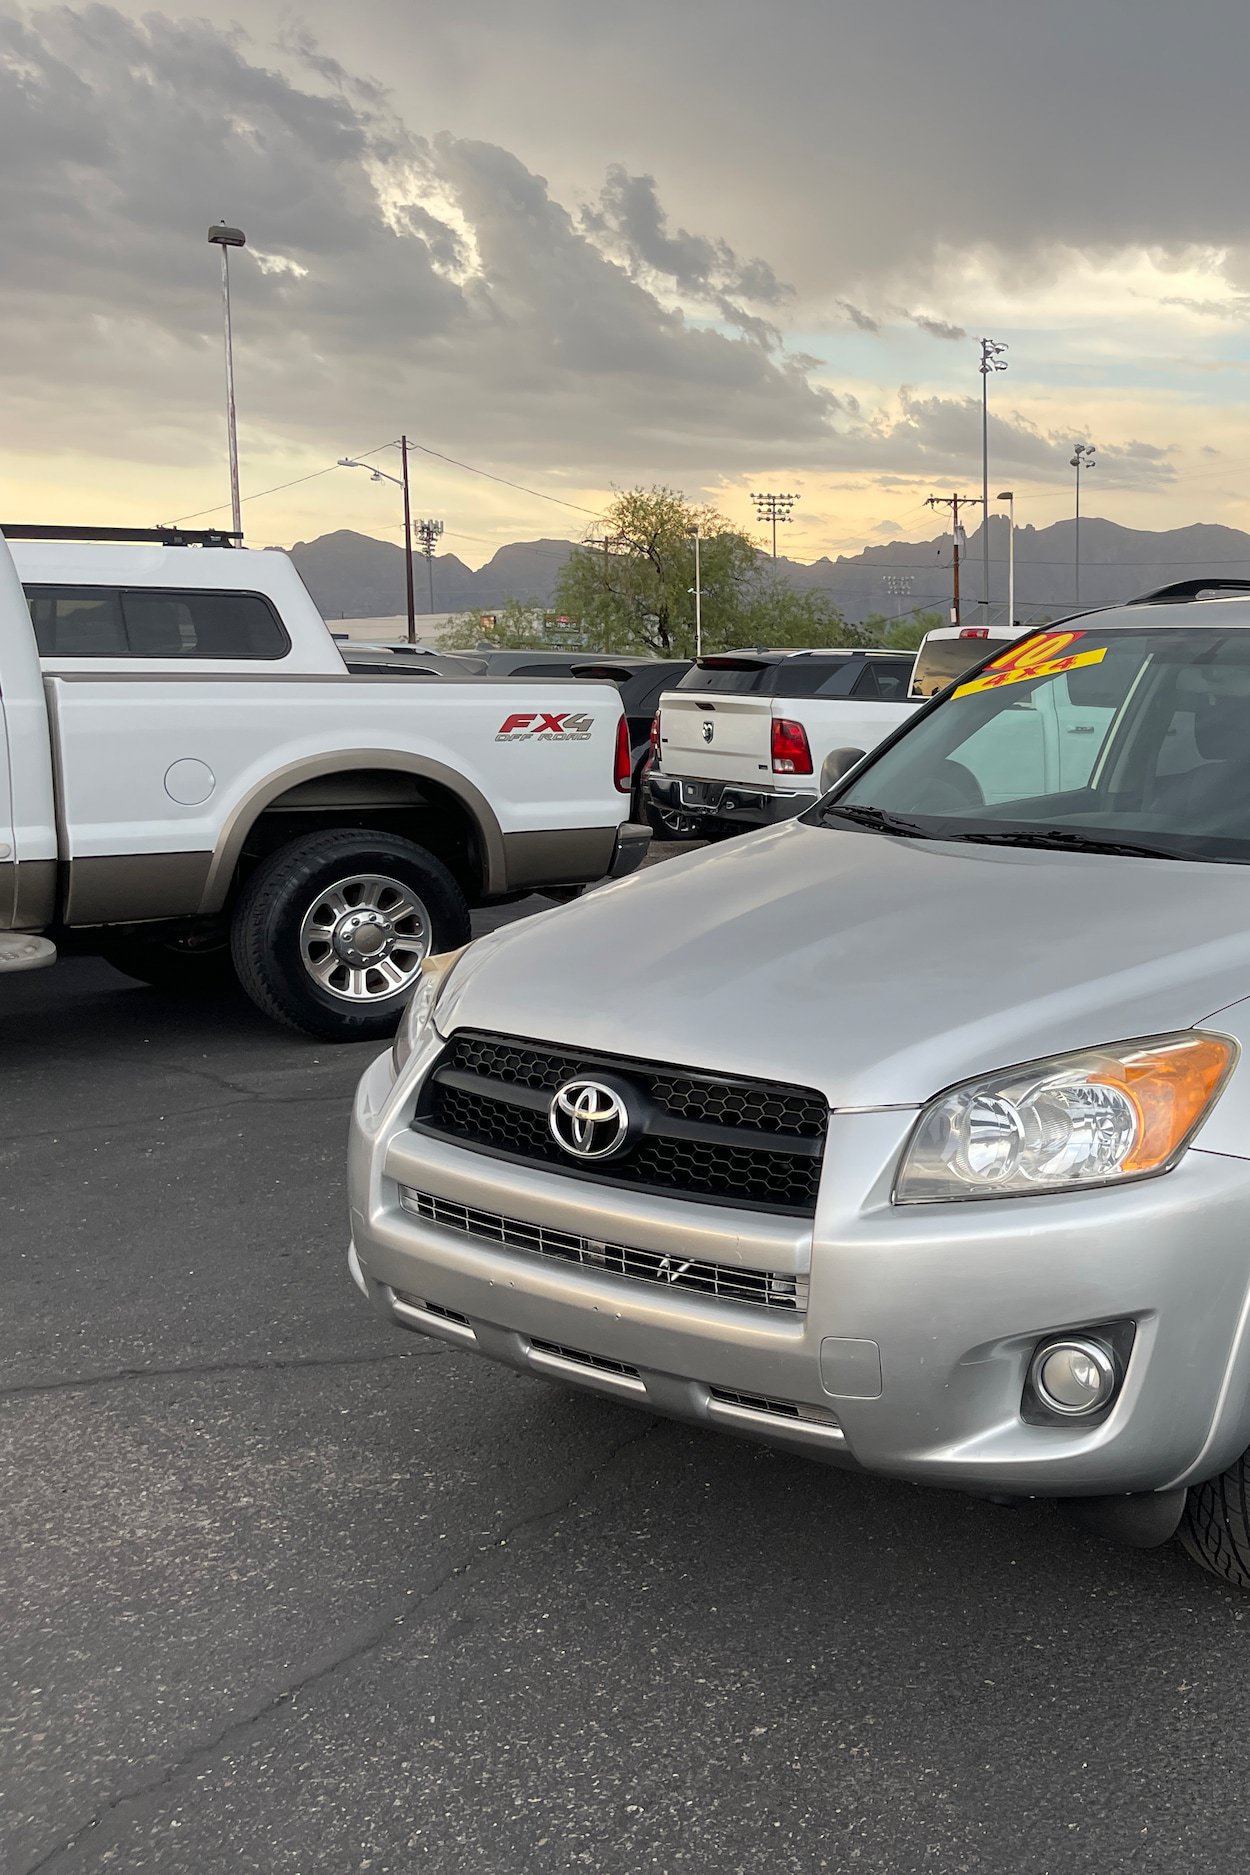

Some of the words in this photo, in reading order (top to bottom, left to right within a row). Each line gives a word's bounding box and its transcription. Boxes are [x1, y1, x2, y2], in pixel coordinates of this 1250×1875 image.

[990, 632, 1076, 669] 10
[498, 713, 595, 733] FX4
[494, 733, 534, 742] OFF
[537, 732, 592, 741] ROAD
